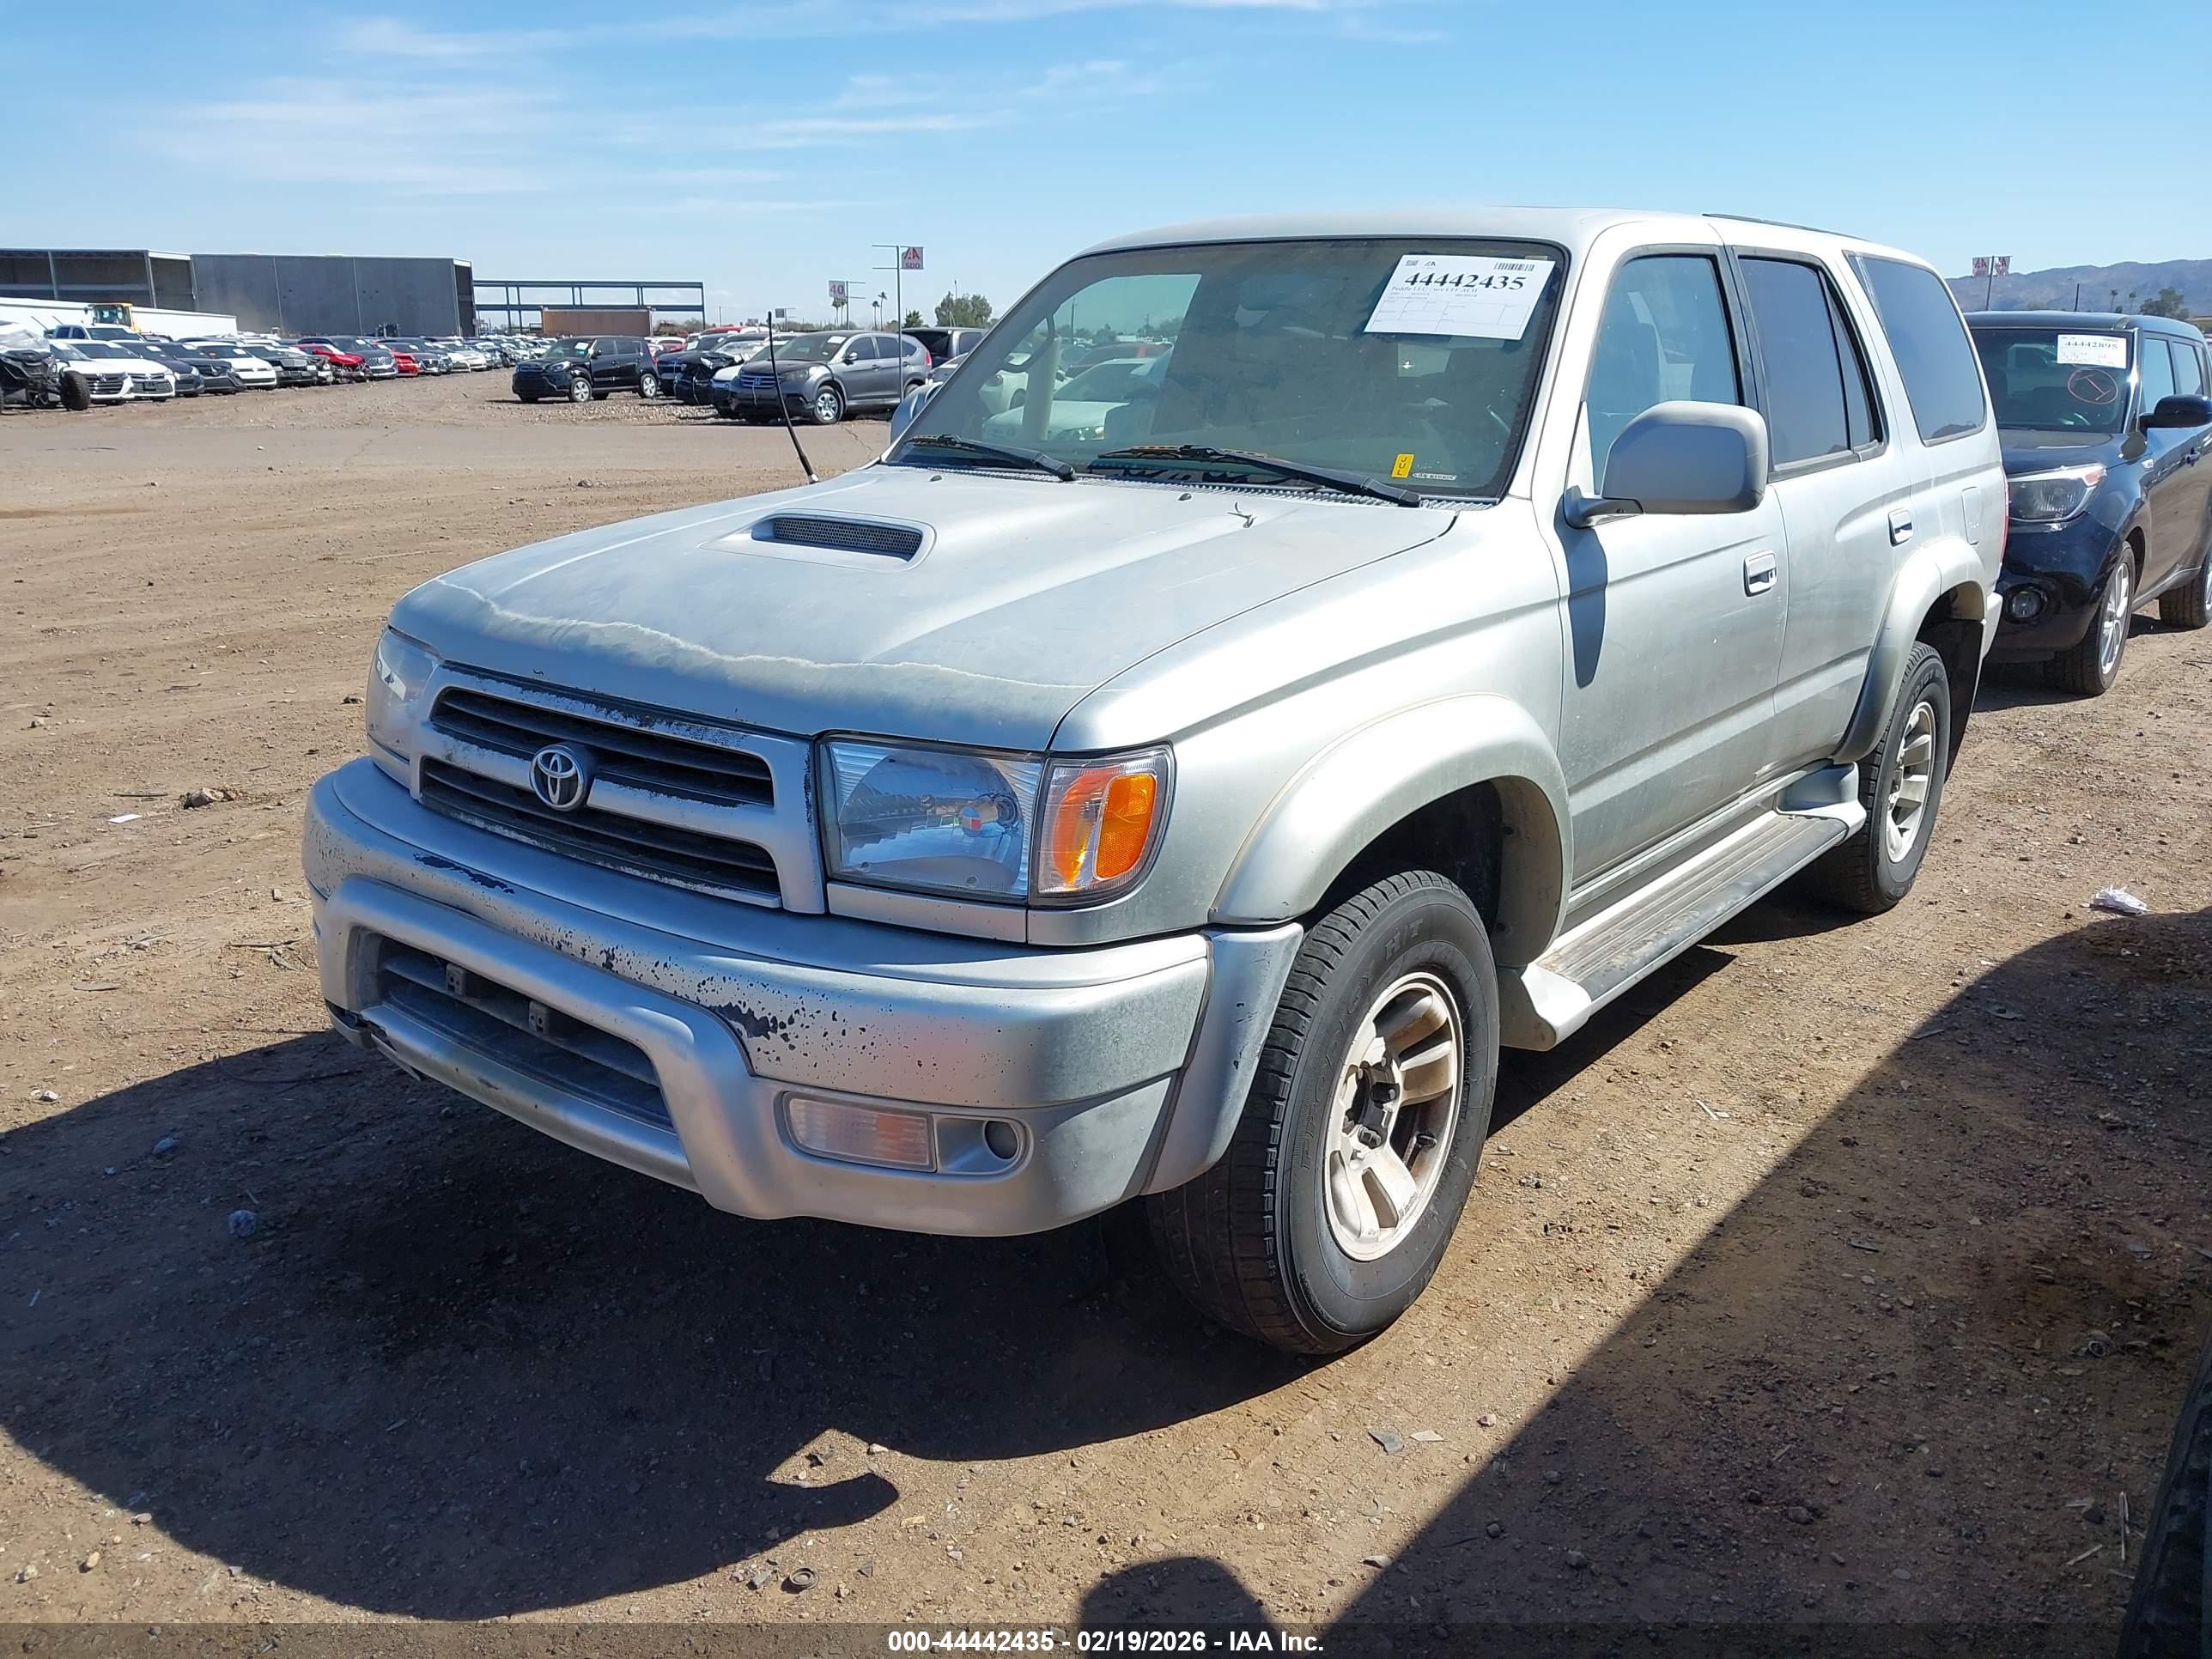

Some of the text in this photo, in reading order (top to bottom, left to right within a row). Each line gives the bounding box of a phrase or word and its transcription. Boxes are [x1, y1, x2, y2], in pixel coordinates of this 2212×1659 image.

[830, 284, 844, 295] 40
[1405, 272, 1527, 290] 44442435
[1396, 457, 1407, 476] JUL
